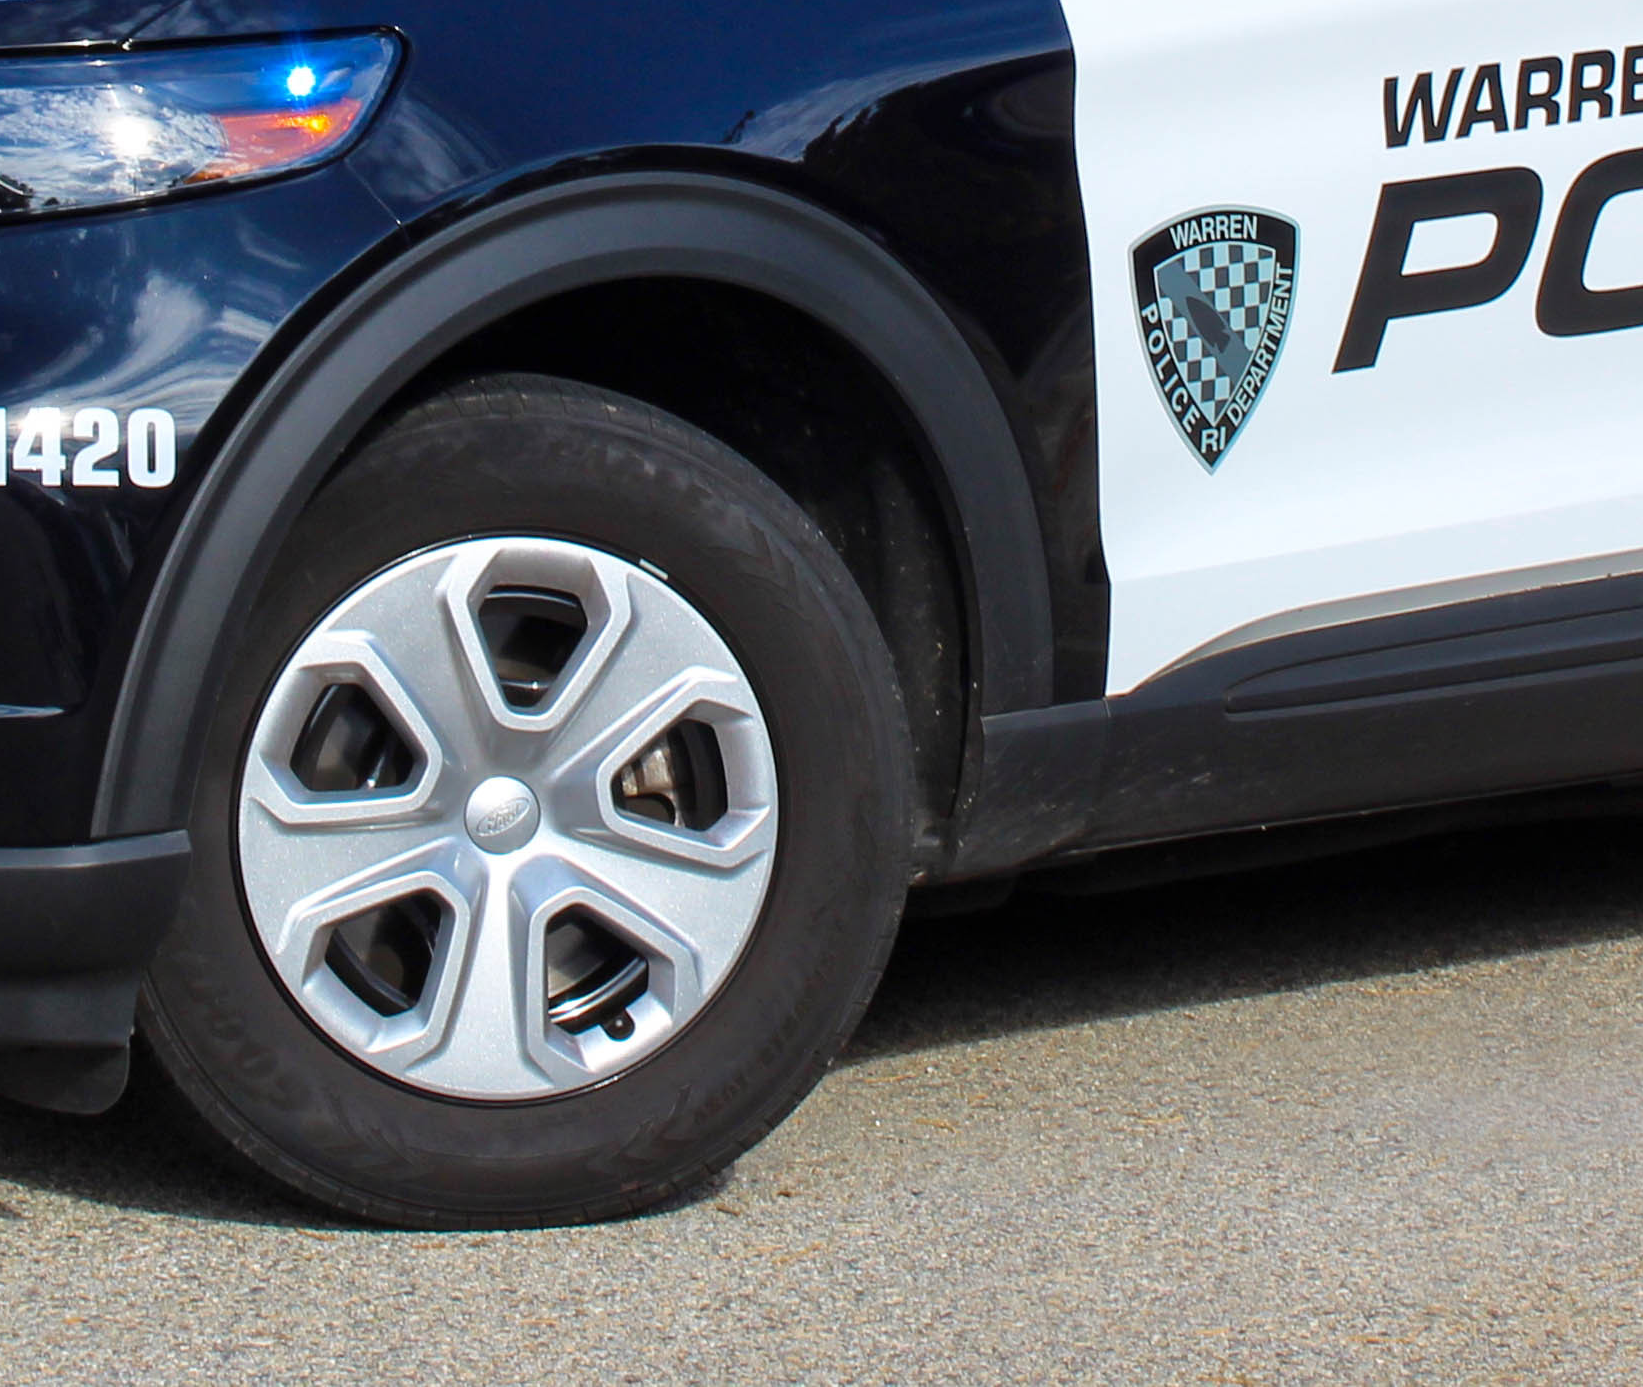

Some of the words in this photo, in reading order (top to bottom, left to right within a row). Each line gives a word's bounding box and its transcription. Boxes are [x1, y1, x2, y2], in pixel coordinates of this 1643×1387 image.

[1169, 214, 1258, 250] WARREN
[1141, 302, 1201, 433] POLICE
[1226, 263, 1293, 427] DEPARTMENT
[1200, 426, 1227, 453] RI
